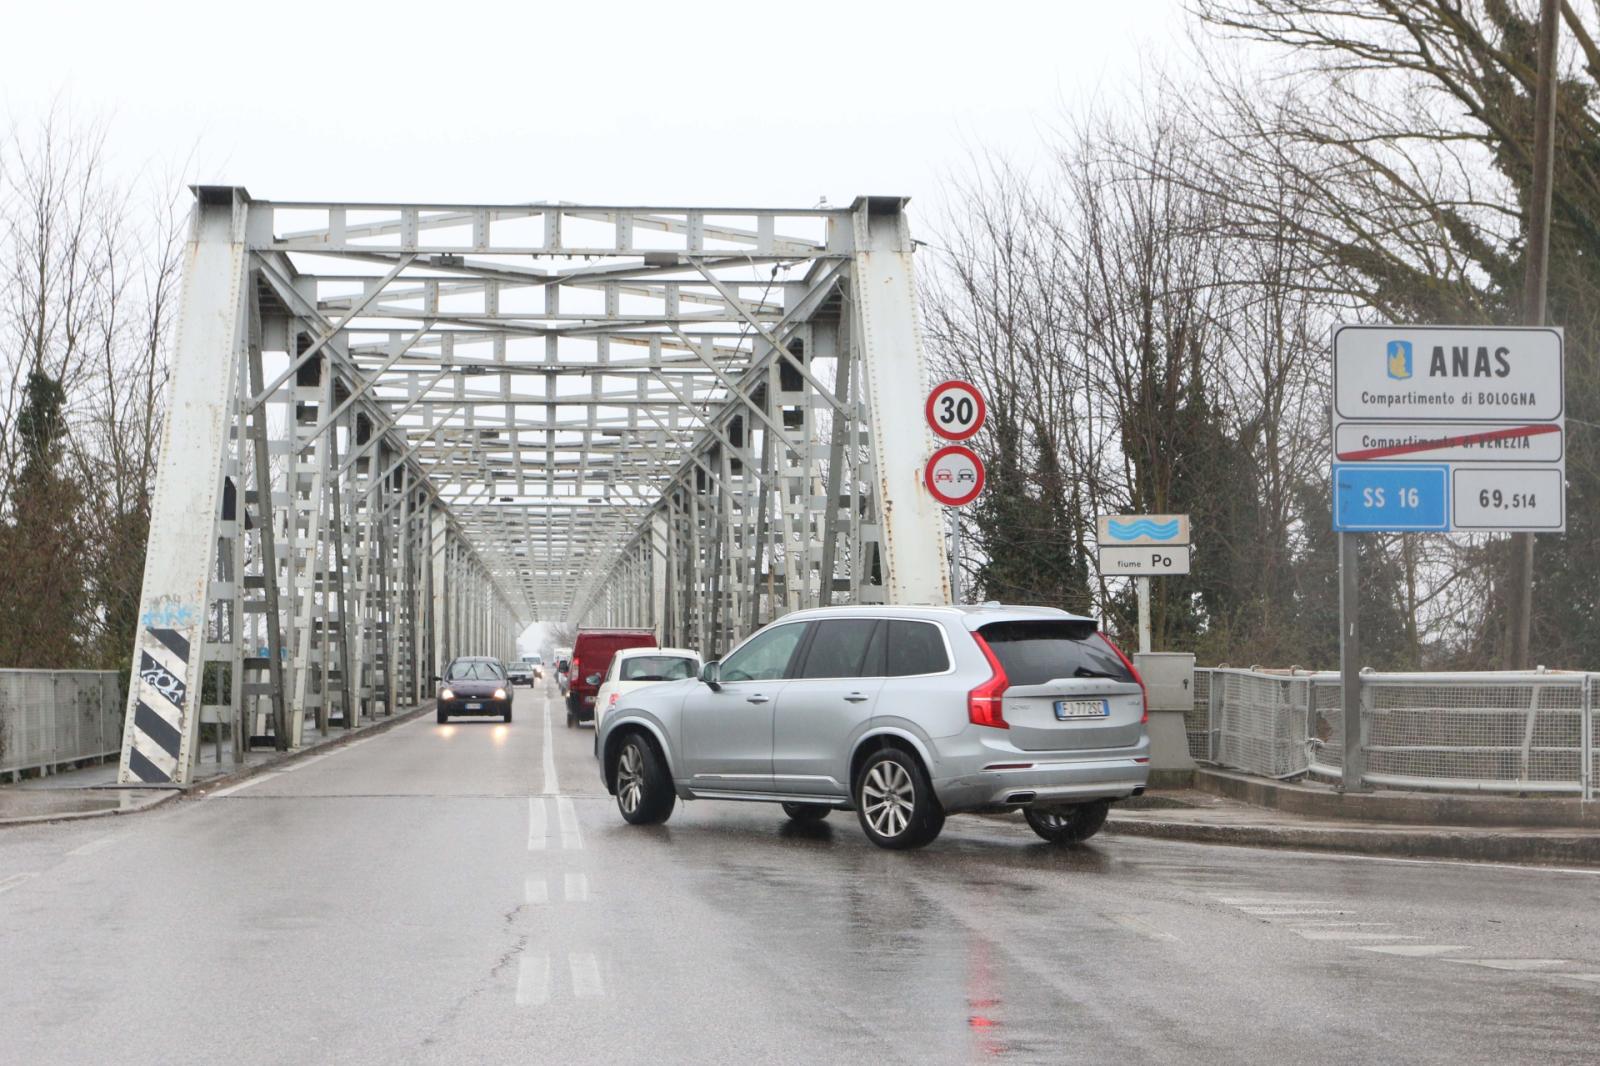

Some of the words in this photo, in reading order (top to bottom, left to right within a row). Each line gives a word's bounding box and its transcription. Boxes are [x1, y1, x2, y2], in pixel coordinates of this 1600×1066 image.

[1429, 346, 1511, 378] ANAS
[1361, 391, 1455, 407] Compartimento
[1462, 391, 1473, 405] di
[1478, 392, 1536, 406] BOLOGNA
[940, 396, 973, 425] 30
[1479, 434, 1530, 449] VENEZIA
[1363, 488, 1386, 508] SS
[1398, 488, 1419, 508] 16
[1117, 560, 1142, 568] fiume
[1151, 554, 1172, 567] Po
